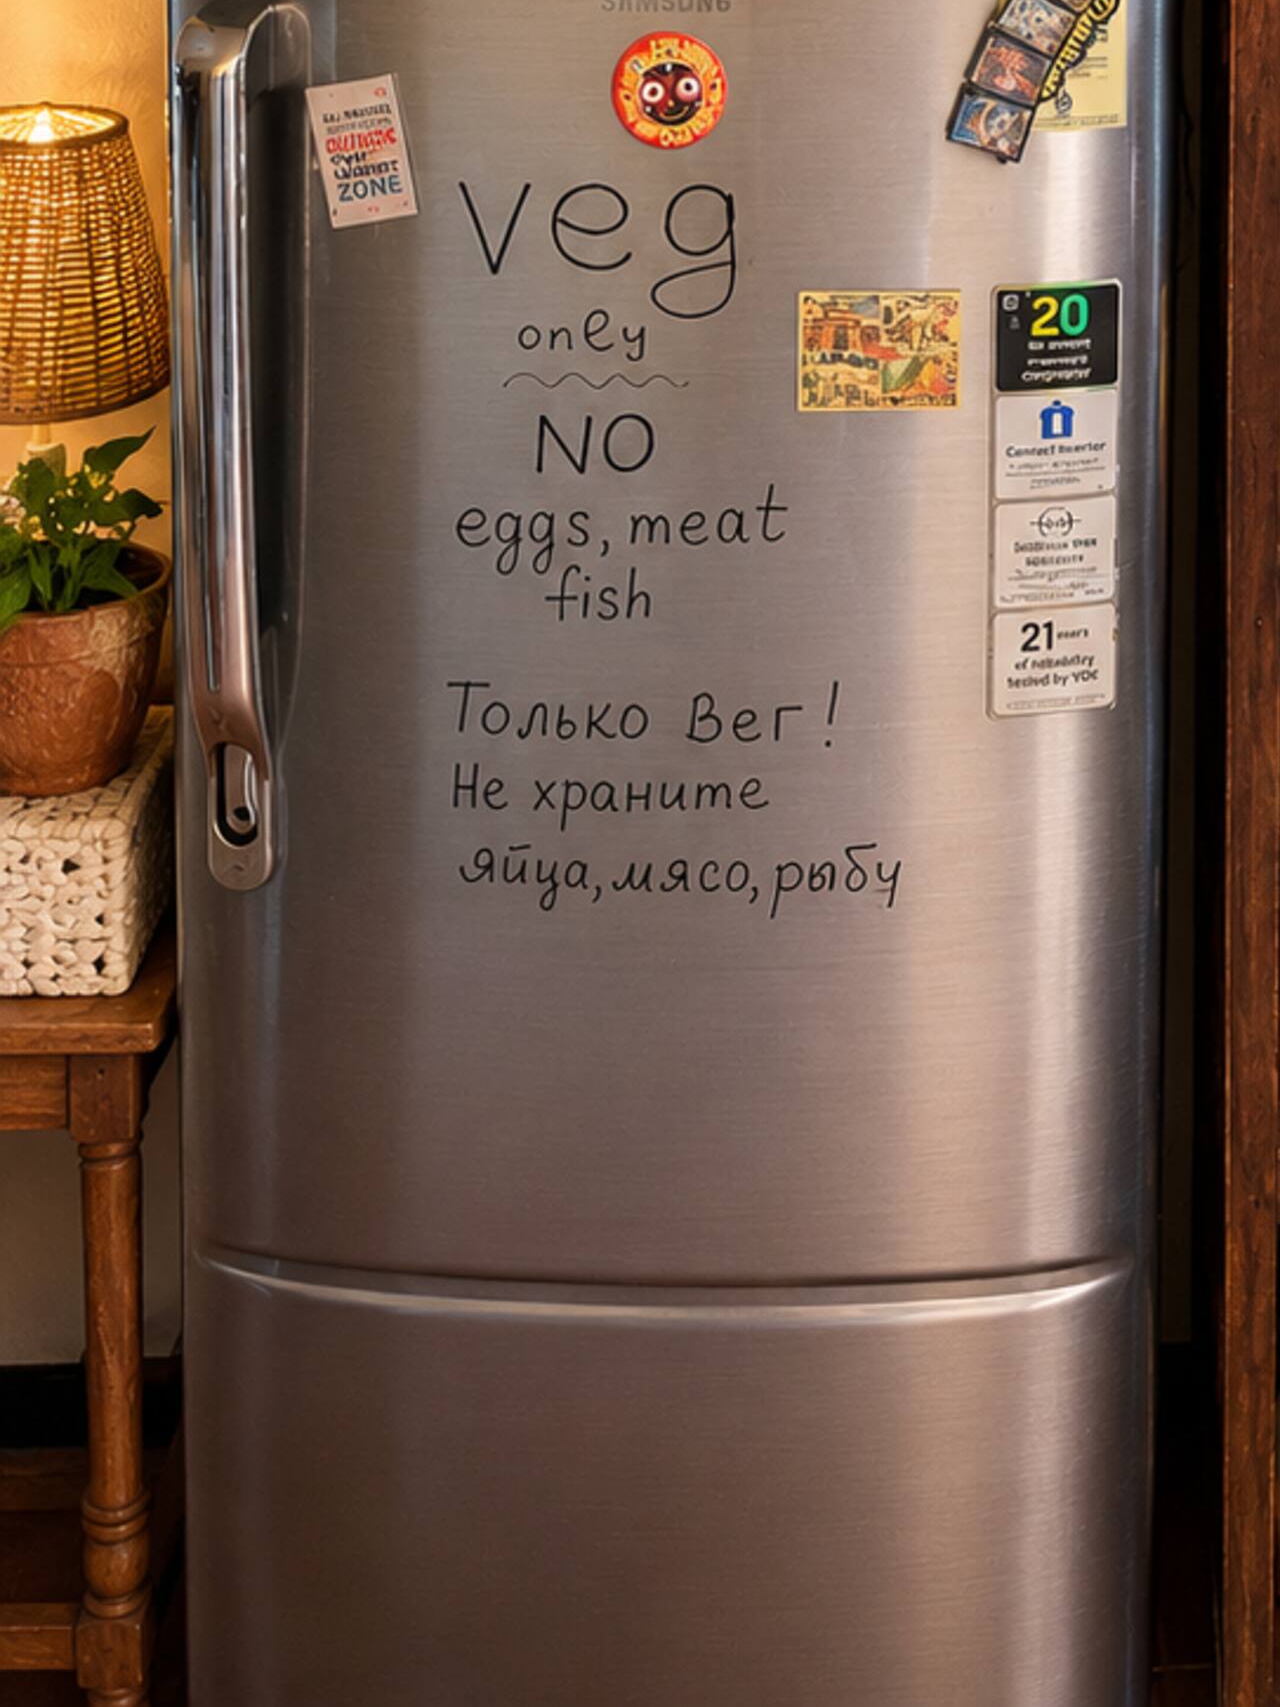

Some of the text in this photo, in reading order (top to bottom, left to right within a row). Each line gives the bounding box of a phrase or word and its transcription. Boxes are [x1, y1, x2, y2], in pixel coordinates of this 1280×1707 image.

[337, 175, 403, 202] ZONE
[1031, 293, 1089, 336] 20
[536, 413, 654, 475] NO
[544, 564, 652, 622] fish
[1020, 620, 1054, 652] 21
[446, 680, 649, 740] Только
[452, 763, 769, 832] Не храните
